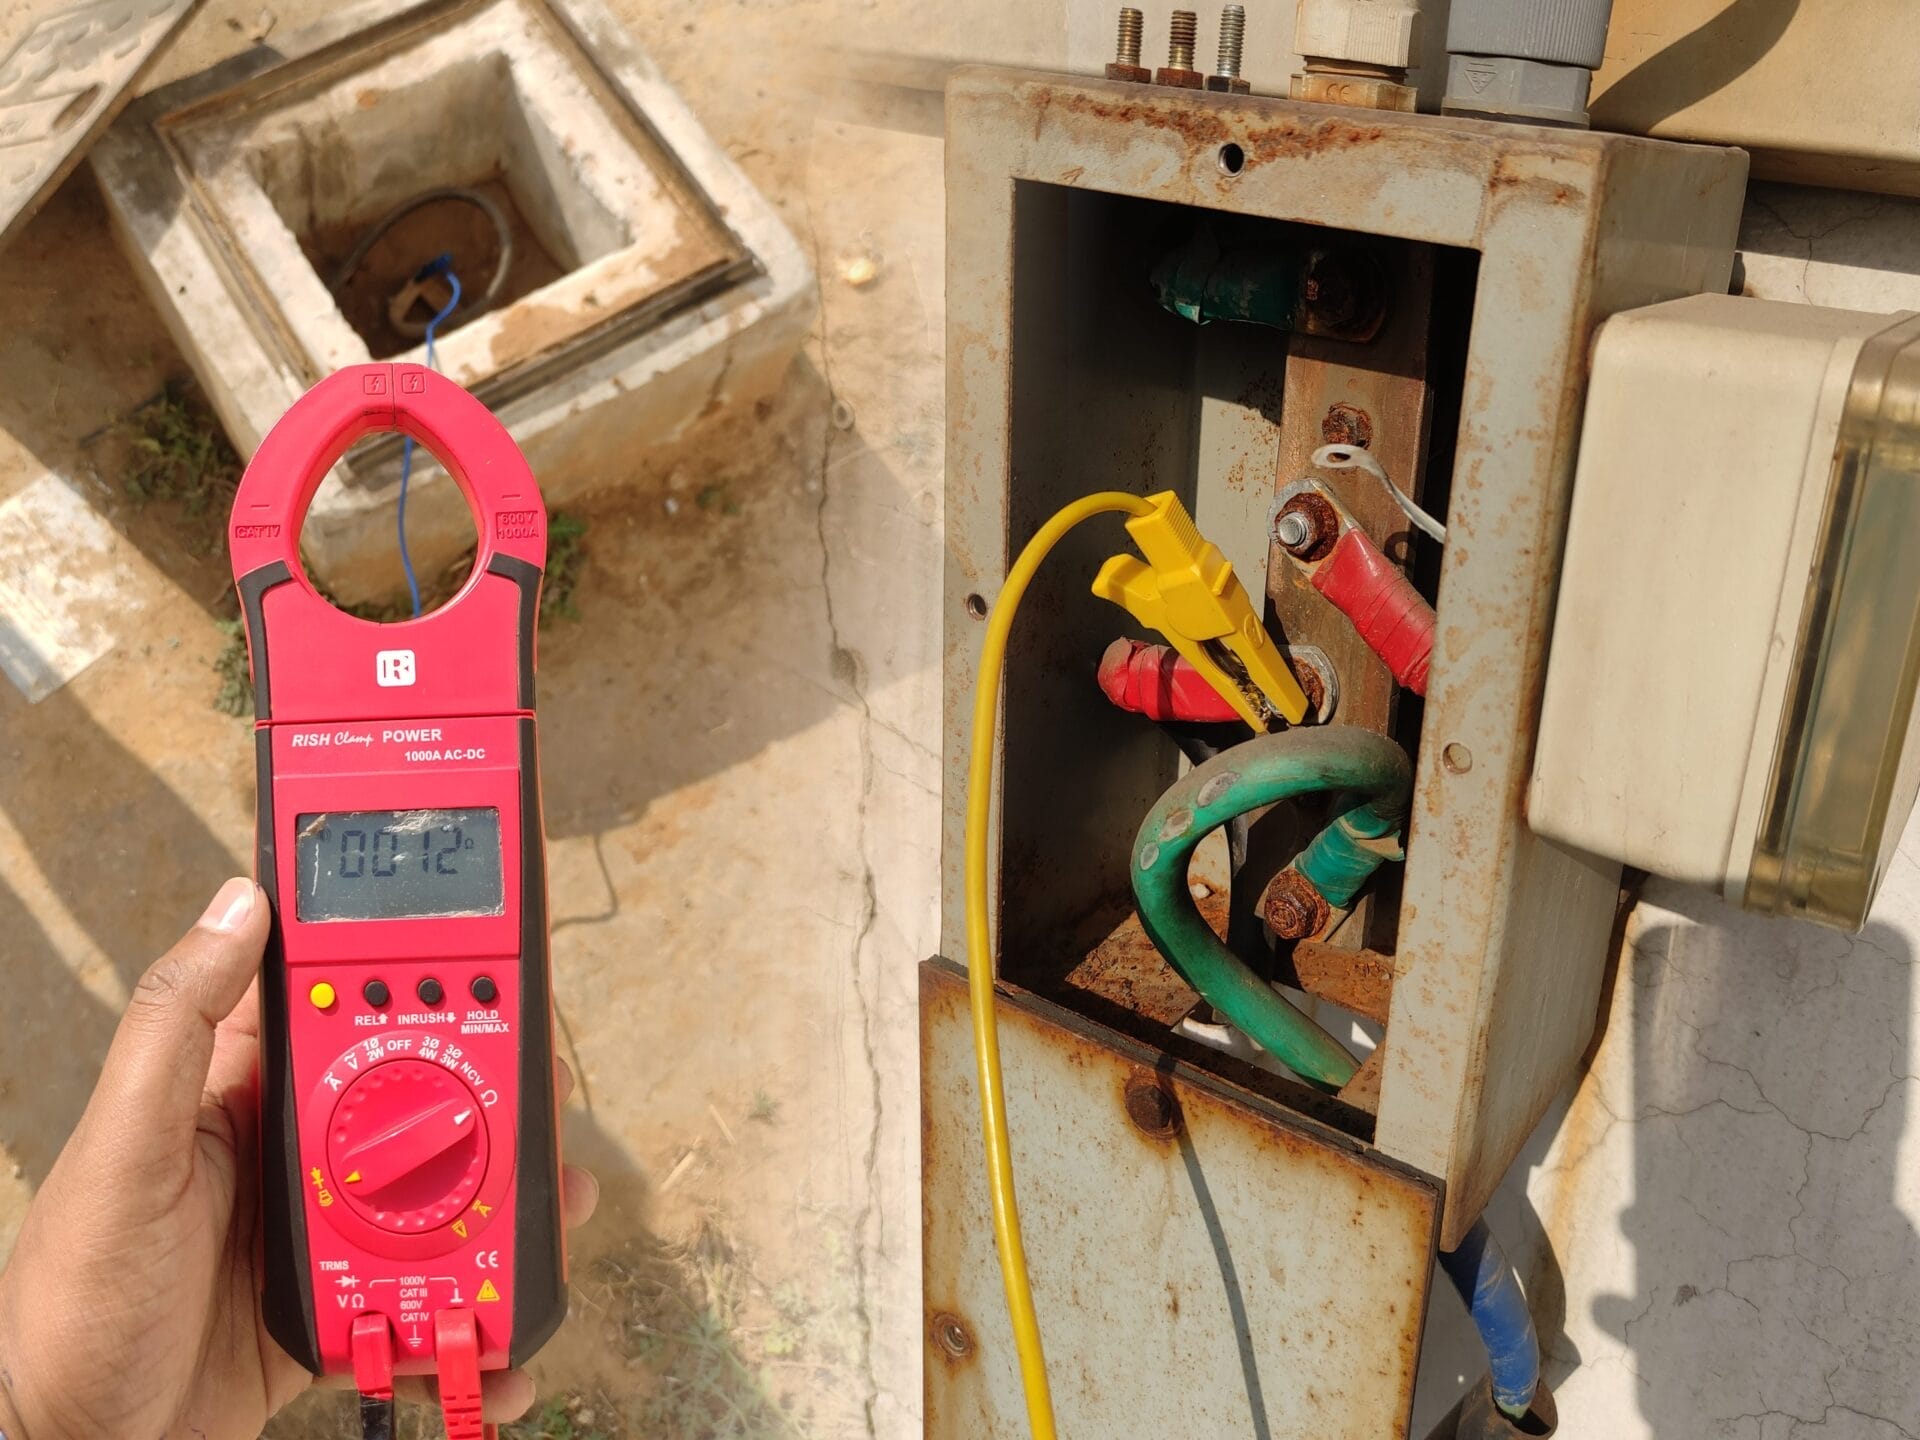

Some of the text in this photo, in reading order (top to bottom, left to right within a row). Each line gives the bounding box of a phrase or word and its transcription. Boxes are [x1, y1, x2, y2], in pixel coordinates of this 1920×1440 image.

[500, 512, 535, 525] 600V
[236, 526, 280, 538] CAT IV
[292, 729, 442, 748] RISH Clamp POWER
[404, 748, 486, 762] 1000A AC-DC
[355, 1015, 379, 1026] REL
[398, 1013, 445, 1025] INRUSH
[467, 1010, 499, 1021] HOLD
[461, 1022, 509, 1034] MIN/MAX
[387, 1039, 413, 1051] OFF
[367, 1046, 384, 1062] 2W
[418, 1047, 438, 1060] 4W
[440, 1053, 459, 1070] 3W
[461, 1061, 484, 1086] NCV
[476, 1250, 499, 1268] CE
[320, 1260, 349, 1271] TRMS
[399, 1275, 426, 1286] 1000V
[400, 1287, 428, 1298] CAT III
[400, 1299, 423, 1310] 600V
[400, 1312, 429, 1322] CAT IV
